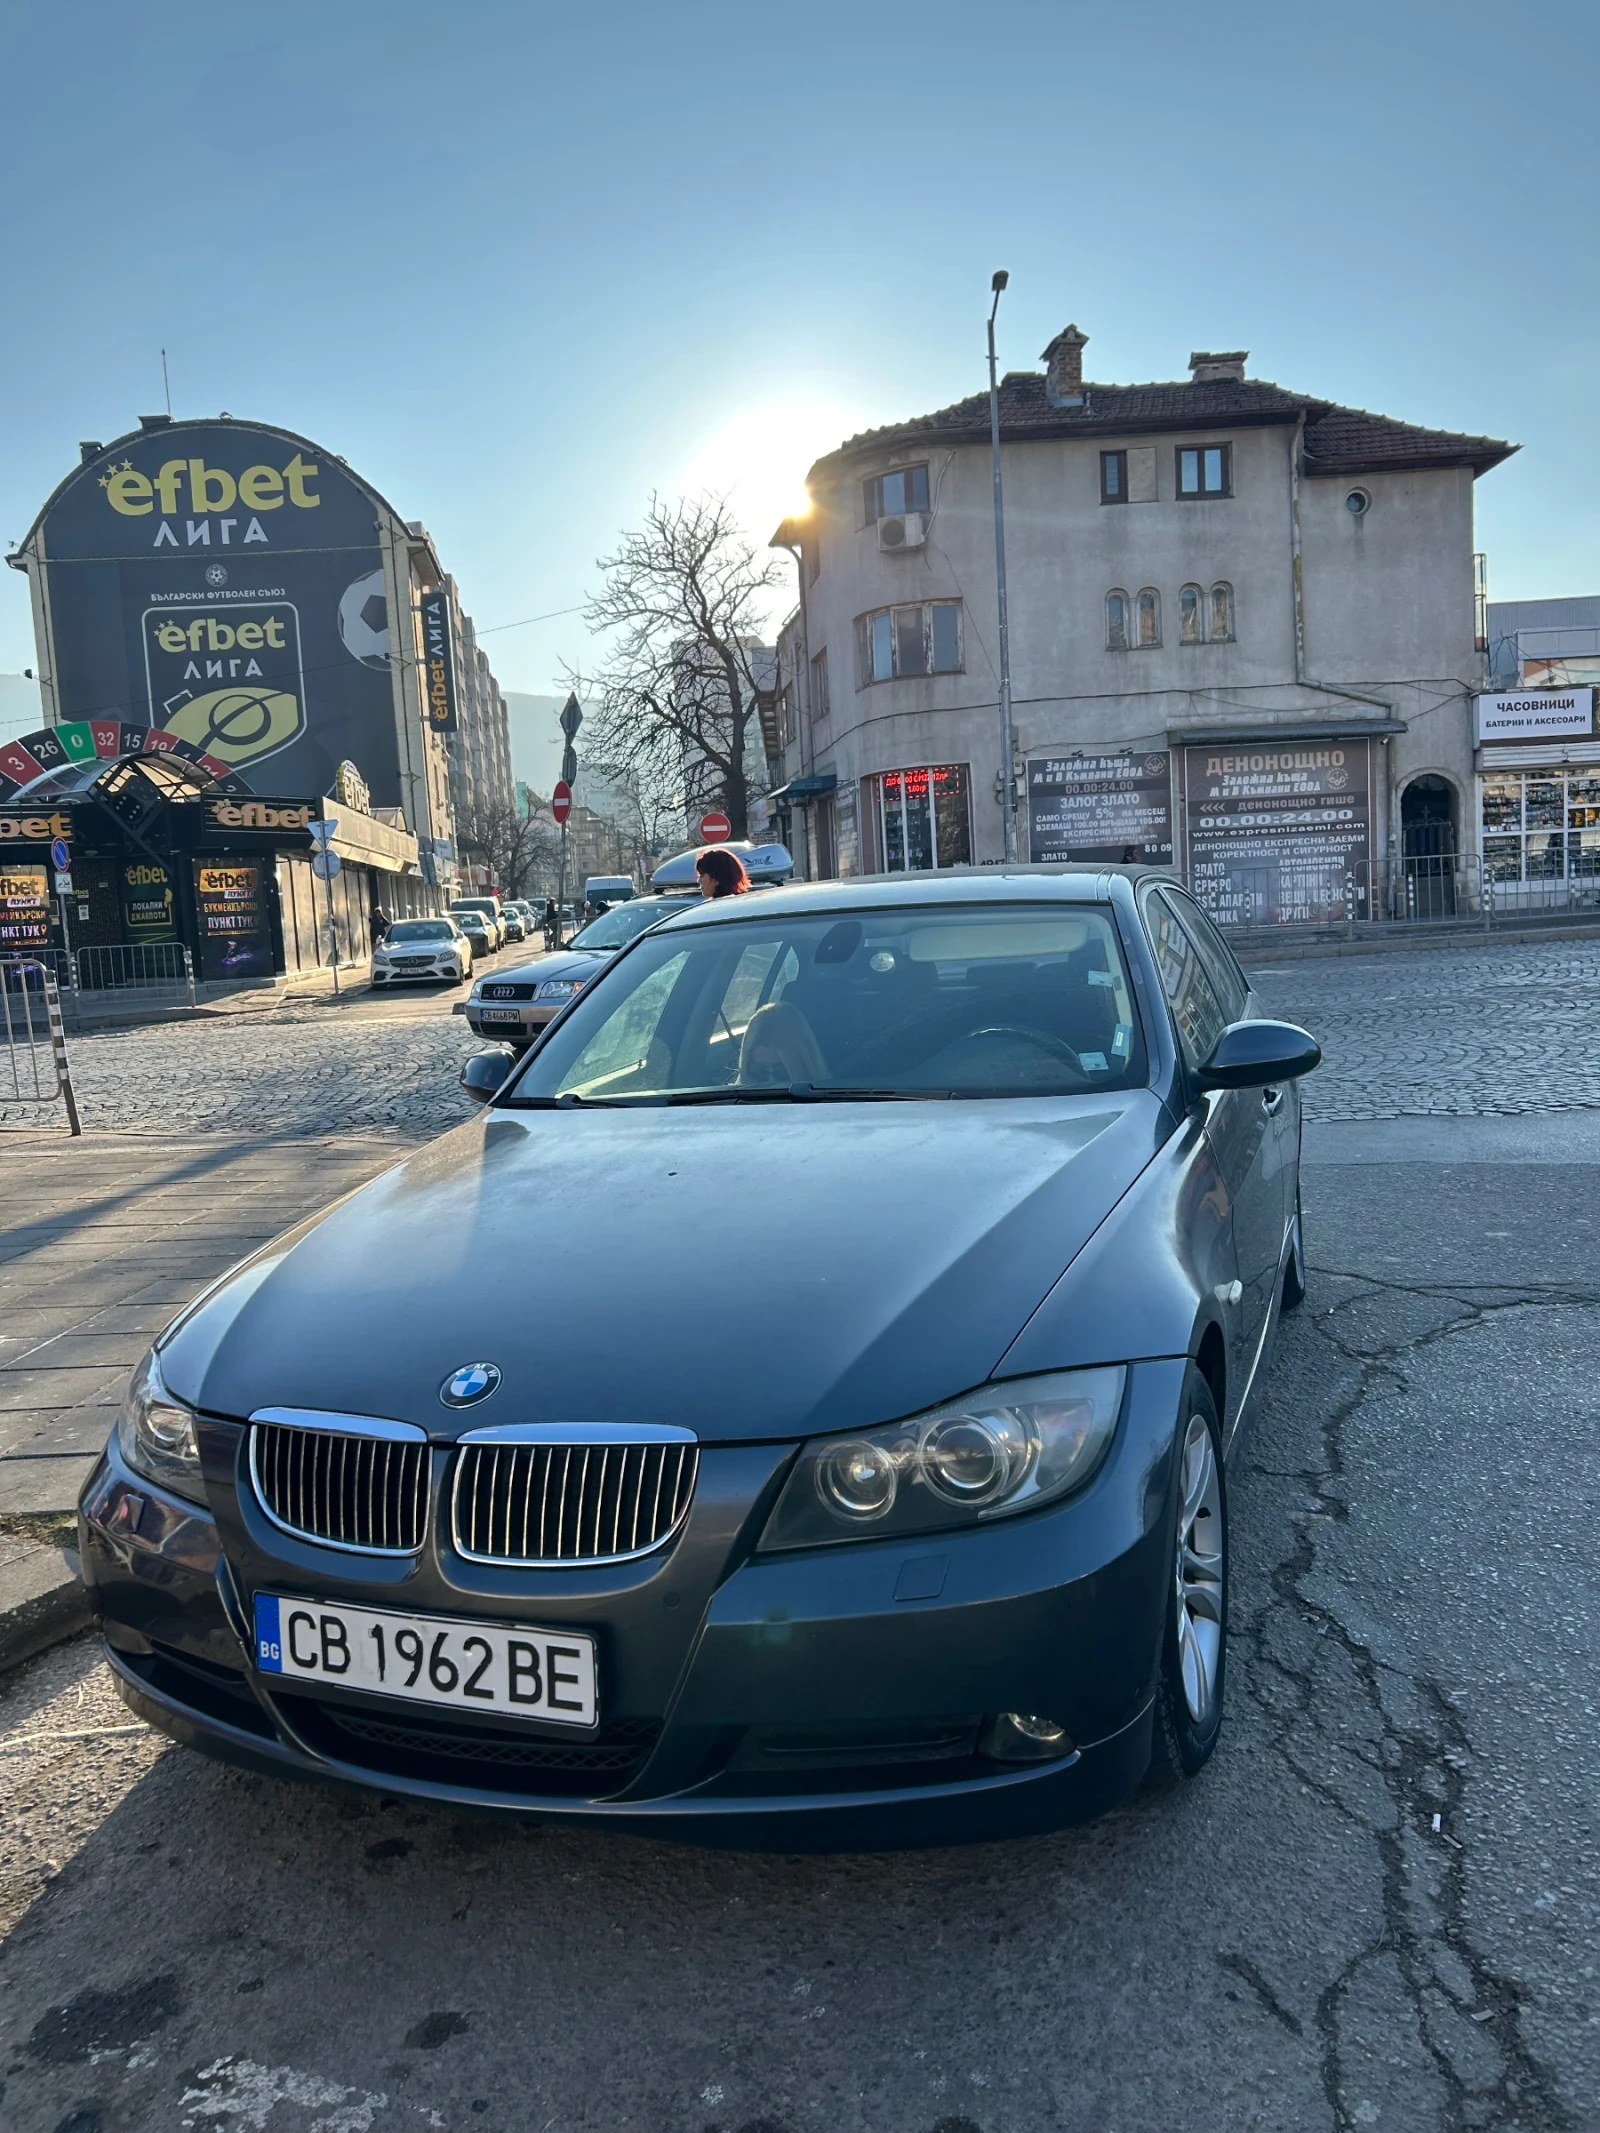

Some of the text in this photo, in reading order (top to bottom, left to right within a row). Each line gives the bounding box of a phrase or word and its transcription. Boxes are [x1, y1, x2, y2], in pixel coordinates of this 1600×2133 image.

[106, 453, 320, 516] efbet
[153, 517, 269, 547] ЛИГА
[151, 588, 286, 601] БЪЛГАРСКИ ФУТБОЛЕН СЪЮЗ
[158, 615, 286, 653] efbet
[184, 658, 263, 679] ЛИГА
[427, 601, 449, 721] efbet ЛИГА
[1497, 699, 1575, 713] ЧАСОВНИЦИ
[1485, 715, 1586, 728] БАТЕРИИ И АКСЕСОАРИ
[8, 755, 26, 771] 3
[33, 740, 59, 760] 26
[73, 734, 83, 748] 0
[97, 732, 115, 746] 32
[124, 733, 141, 748] 15
[1206, 750, 1345, 777] ДЕНОНОЩНО
[1034, 773, 1043, 783] М
[1066, 770, 1114, 781] Къмпани
[1116, 767, 1143, 778] ЕООД
[1222, 774, 1273, 786] Заложна
[1065, 781, 1134, 794] 00.00:24.00
[1209, 787, 1219, 797] М
[1242, 784, 1291, 795] Къмпани
[1293, 781, 1321, 792] ЕООД
[1060, 793, 1140, 809] ЗАЛОГ ЗЛАТО
[1237, 795, 1355, 812] денонощно гише
[1036, 807, 1166, 823] САМО СРЕЩУ 5% НА МЕСЕЦ!
[1200, 810, 1353, 828] 00.00:24.00
[1036, 822, 1072, 832] ВЗЕМАШ
[1100, 818, 1137, 827] ВРЪЩАШ
[1063, 826, 1142, 838] ЕКСПРЕСНИ ЗАЕМИ
[1193, 822, 1365, 837] www.expresnizaemi.com
[1144, 843, 1172, 853] 80 09
[1193, 834, 1365, 852] ДЕНОНОЩНО ЕКСПРЕСНИ ЗАЕМИ
[1041, 852, 1068, 861] ЗЛАТО
[1213, 844, 1353, 859] КОРЕКТНОСТ И СИГУРНОСТ
[132, 901, 163, 910] ЛОКАЛНИ
[1219, 892, 1263, 907] АПАРТИ
[21, 925, 41, 937] ТУК
[207, 917, 236, 930] ПУНКТ
[260, 1641, 280, 1661] BG
[288, 1611, 583, 1712] CB 1962 BE
